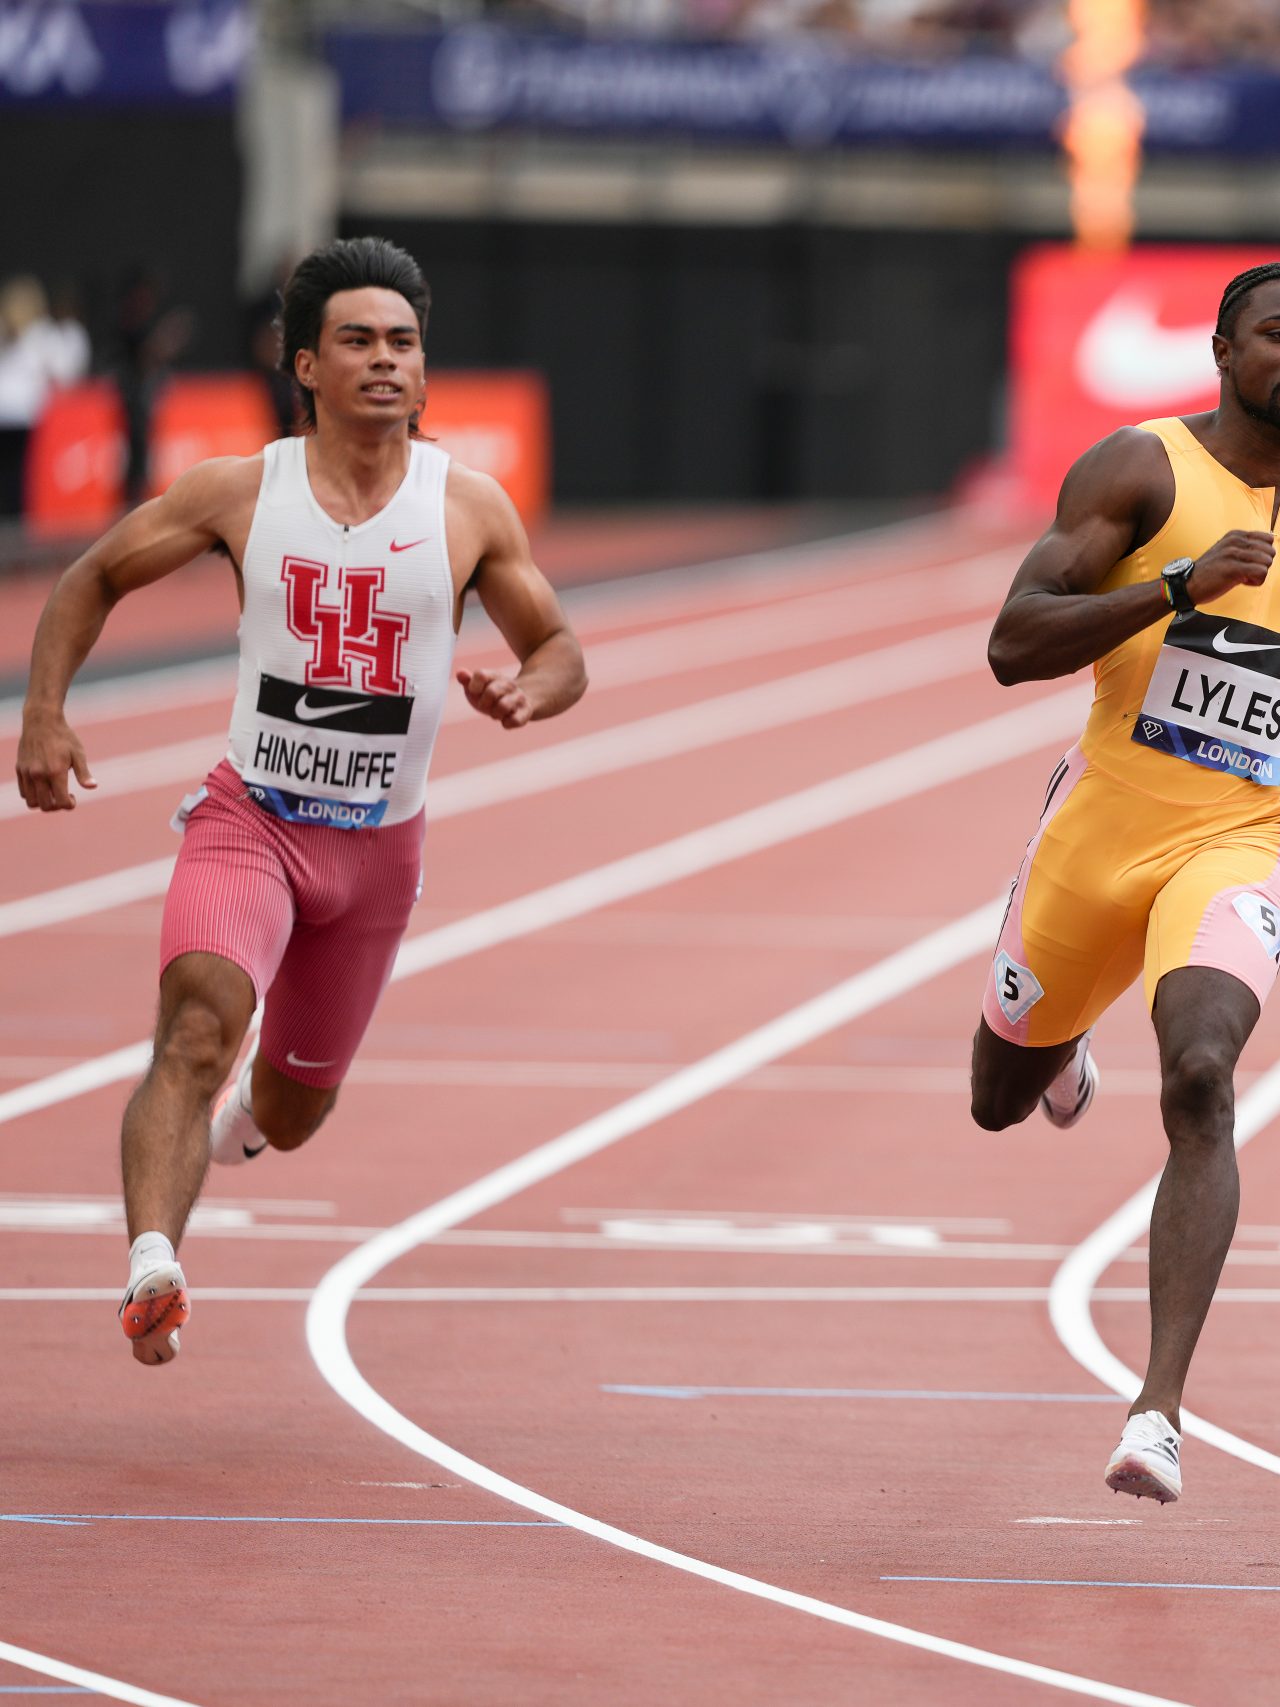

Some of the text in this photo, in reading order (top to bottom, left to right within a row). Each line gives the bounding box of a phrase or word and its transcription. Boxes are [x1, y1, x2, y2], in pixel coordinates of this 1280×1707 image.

[280, 555, 410, 697] UH
[253, 731, 396, 789] HINCHLIFFE
[1196, 740, 1273, 779] LONDON
[298, 799, 371, 826] LONDO
[1260, 904, 1276, 937] 5
[1003, 966, 1020, 1001] 5
